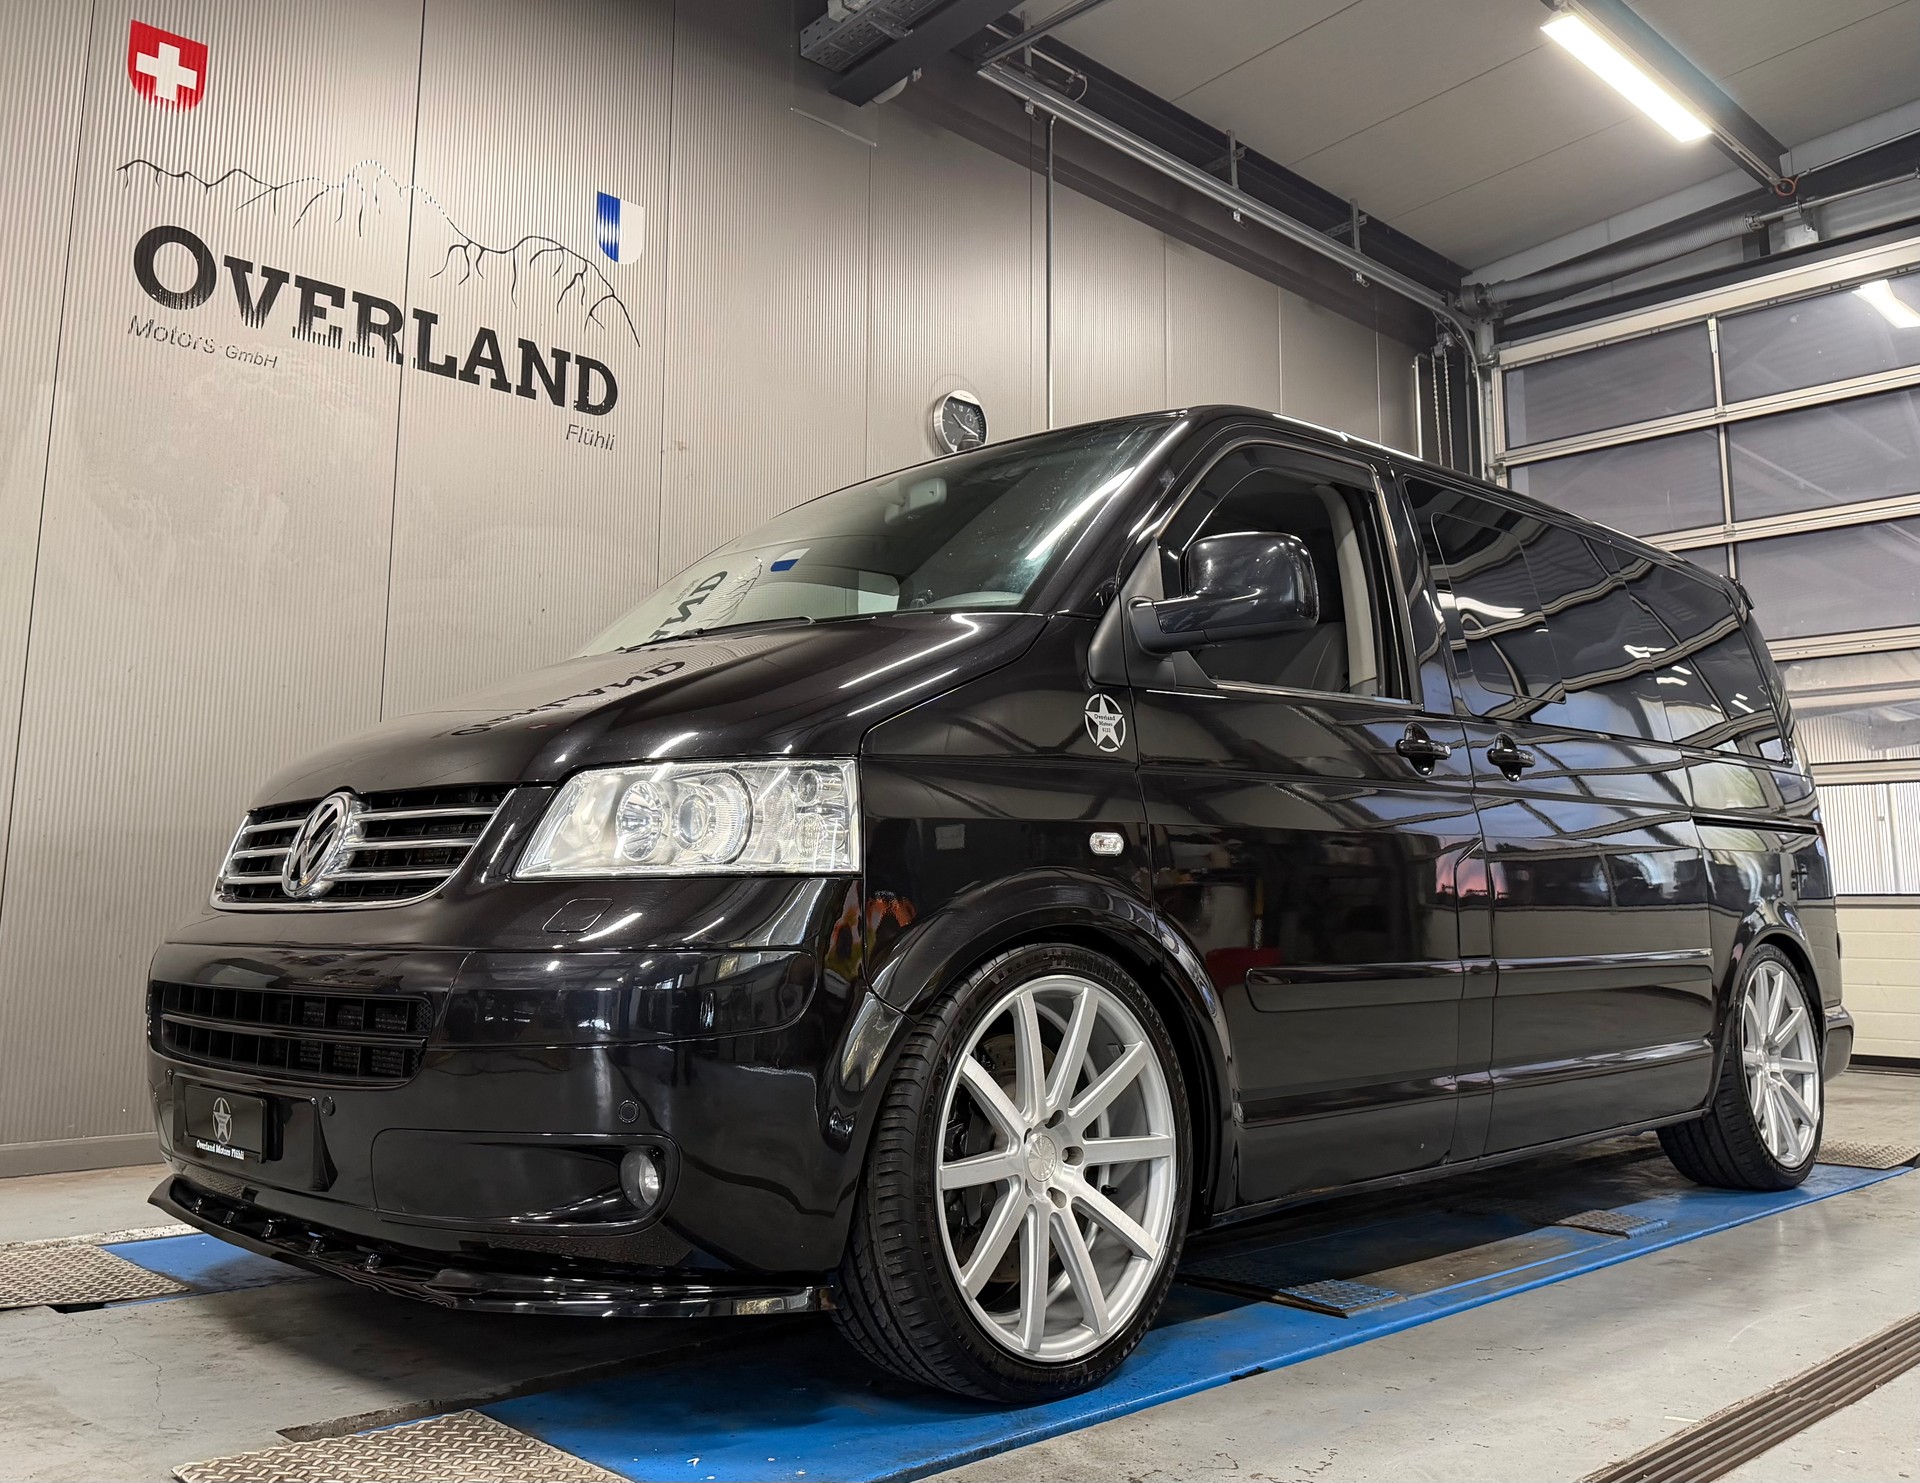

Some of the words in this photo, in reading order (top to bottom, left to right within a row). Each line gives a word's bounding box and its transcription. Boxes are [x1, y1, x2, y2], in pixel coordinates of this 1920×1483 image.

[133, 225, 619, 416] OVERLAND
[127, 314, 217, 355] Motors
[225, 342, 279, 370] GmbH
[565, 423, 616, 452] Flühli
[197, 1139, 215, 1152] Overland
